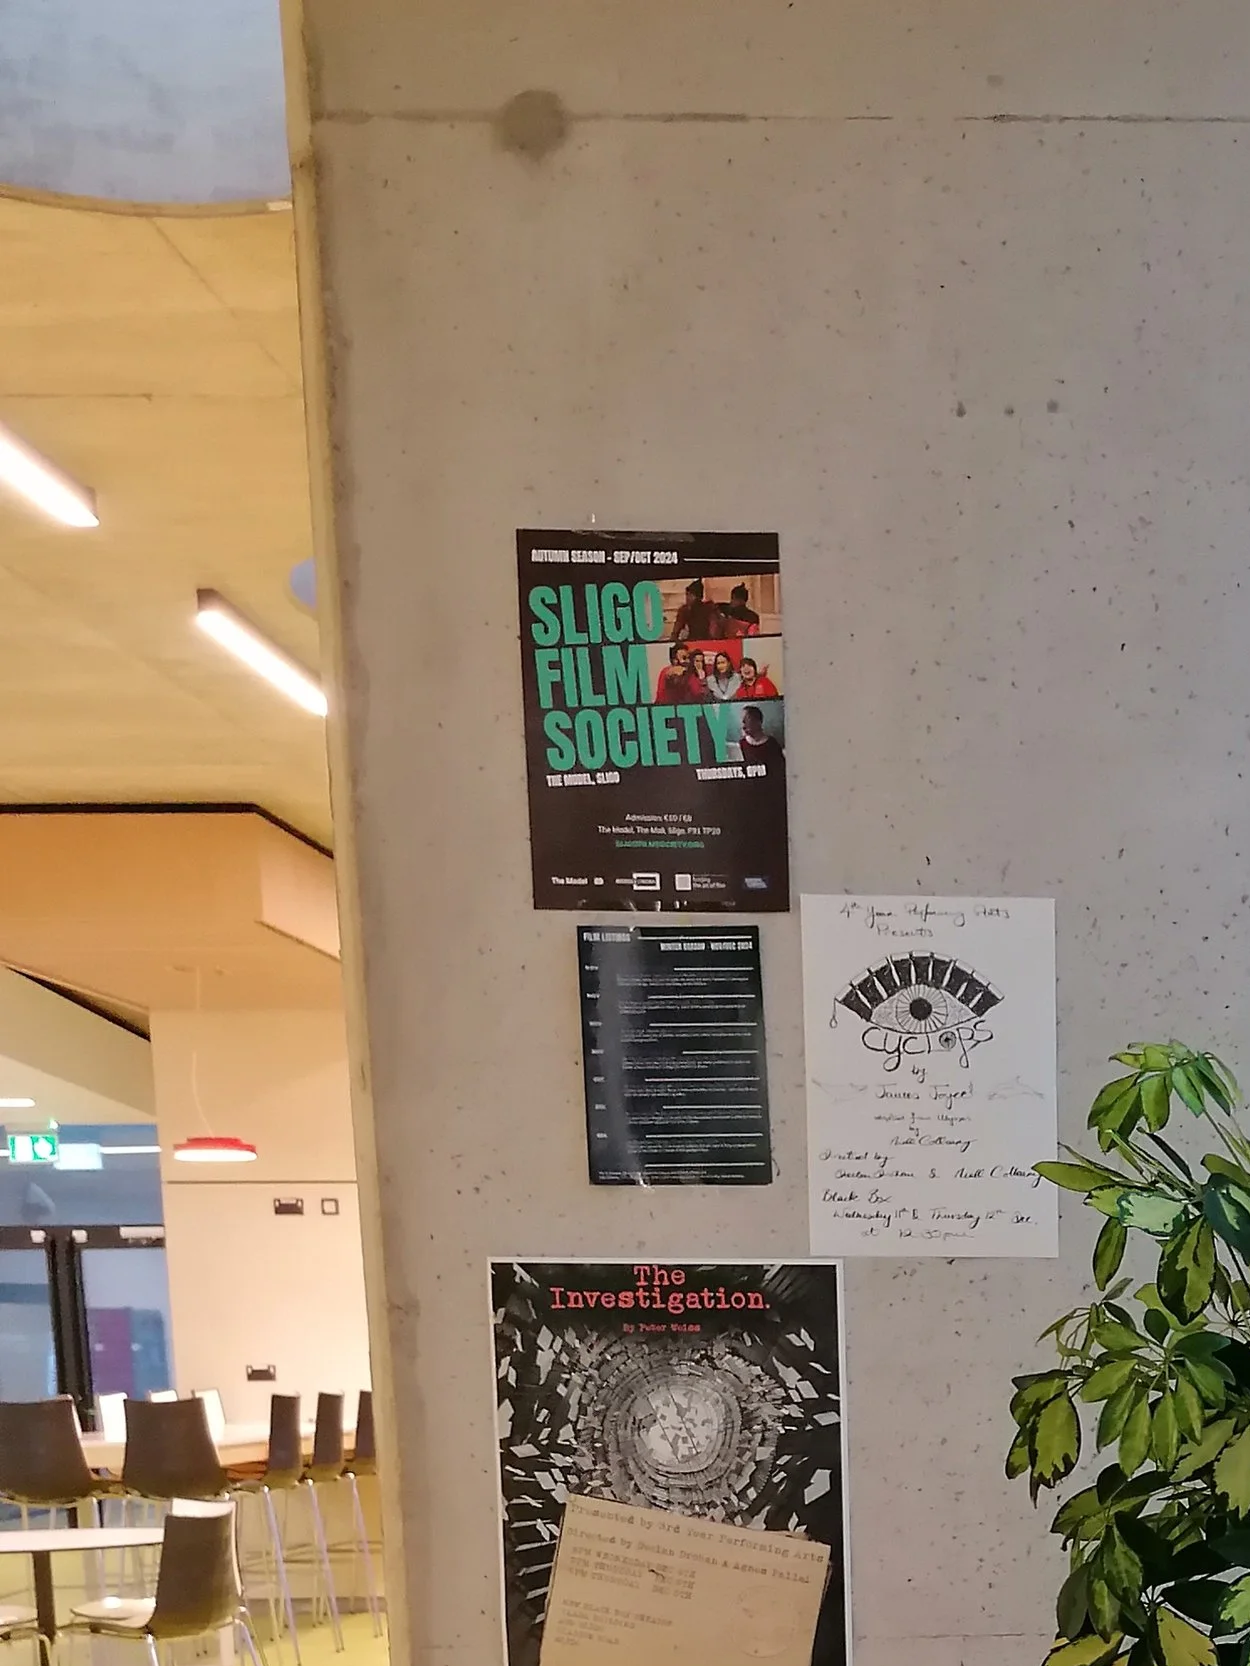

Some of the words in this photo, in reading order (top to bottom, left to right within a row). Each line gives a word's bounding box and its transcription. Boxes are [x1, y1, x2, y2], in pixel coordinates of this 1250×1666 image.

[531, 549, 569, 562] AUTUMN
[571, 550, 605, 563] SEASON
[613, 551, 651, 563] SEP/OCT
[653, 551, 678, 564] 2024
[529, 580, 664, 646] SLIGO
[535, 644, 652, 708] FILM
[543, 703, 730, 770] SOCIETY
[546, 774, 562, 787] THE
[597, 771, 620, 784] SLIGO
[551, 876, 565, 885] The
[565, 877, 588, 885] Model
[911, 1065, 928, 1083] by
[633, 1265, 686, 1286] The
[550, 1286, 771, 1314] Investigation.
[620, 1537, 632, 1550] by
[640, 1517, 653, 1530] by
[719, 1534, 790, 1557] Performing
[794, 1551, 824, 1563] Arts
